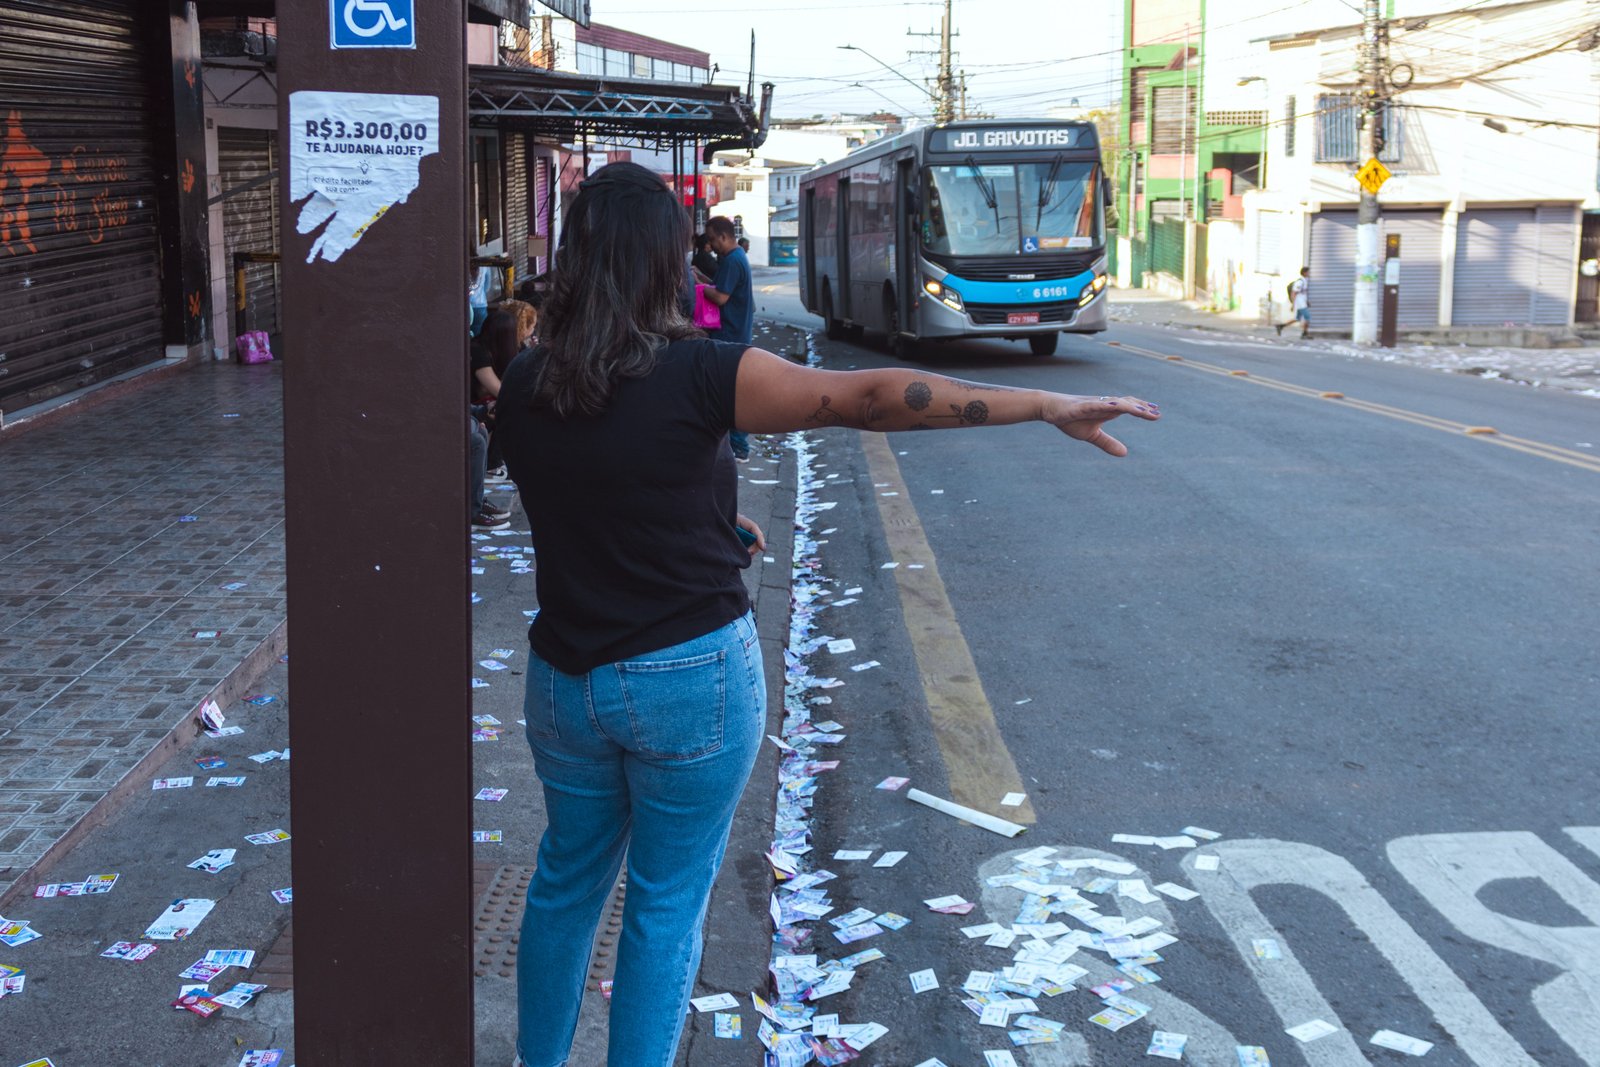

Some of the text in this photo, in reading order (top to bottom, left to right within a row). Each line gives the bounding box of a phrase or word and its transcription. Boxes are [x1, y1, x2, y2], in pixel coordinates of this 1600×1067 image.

[306, 118, 427, 142] R$3.300,00
[954, 129, 1069, 147] JD. GAIVOTAS
[306, 142, 424, 155] TE AJUDARIA HOJE?
[1033, 286, 1067, 298] 6 6161
